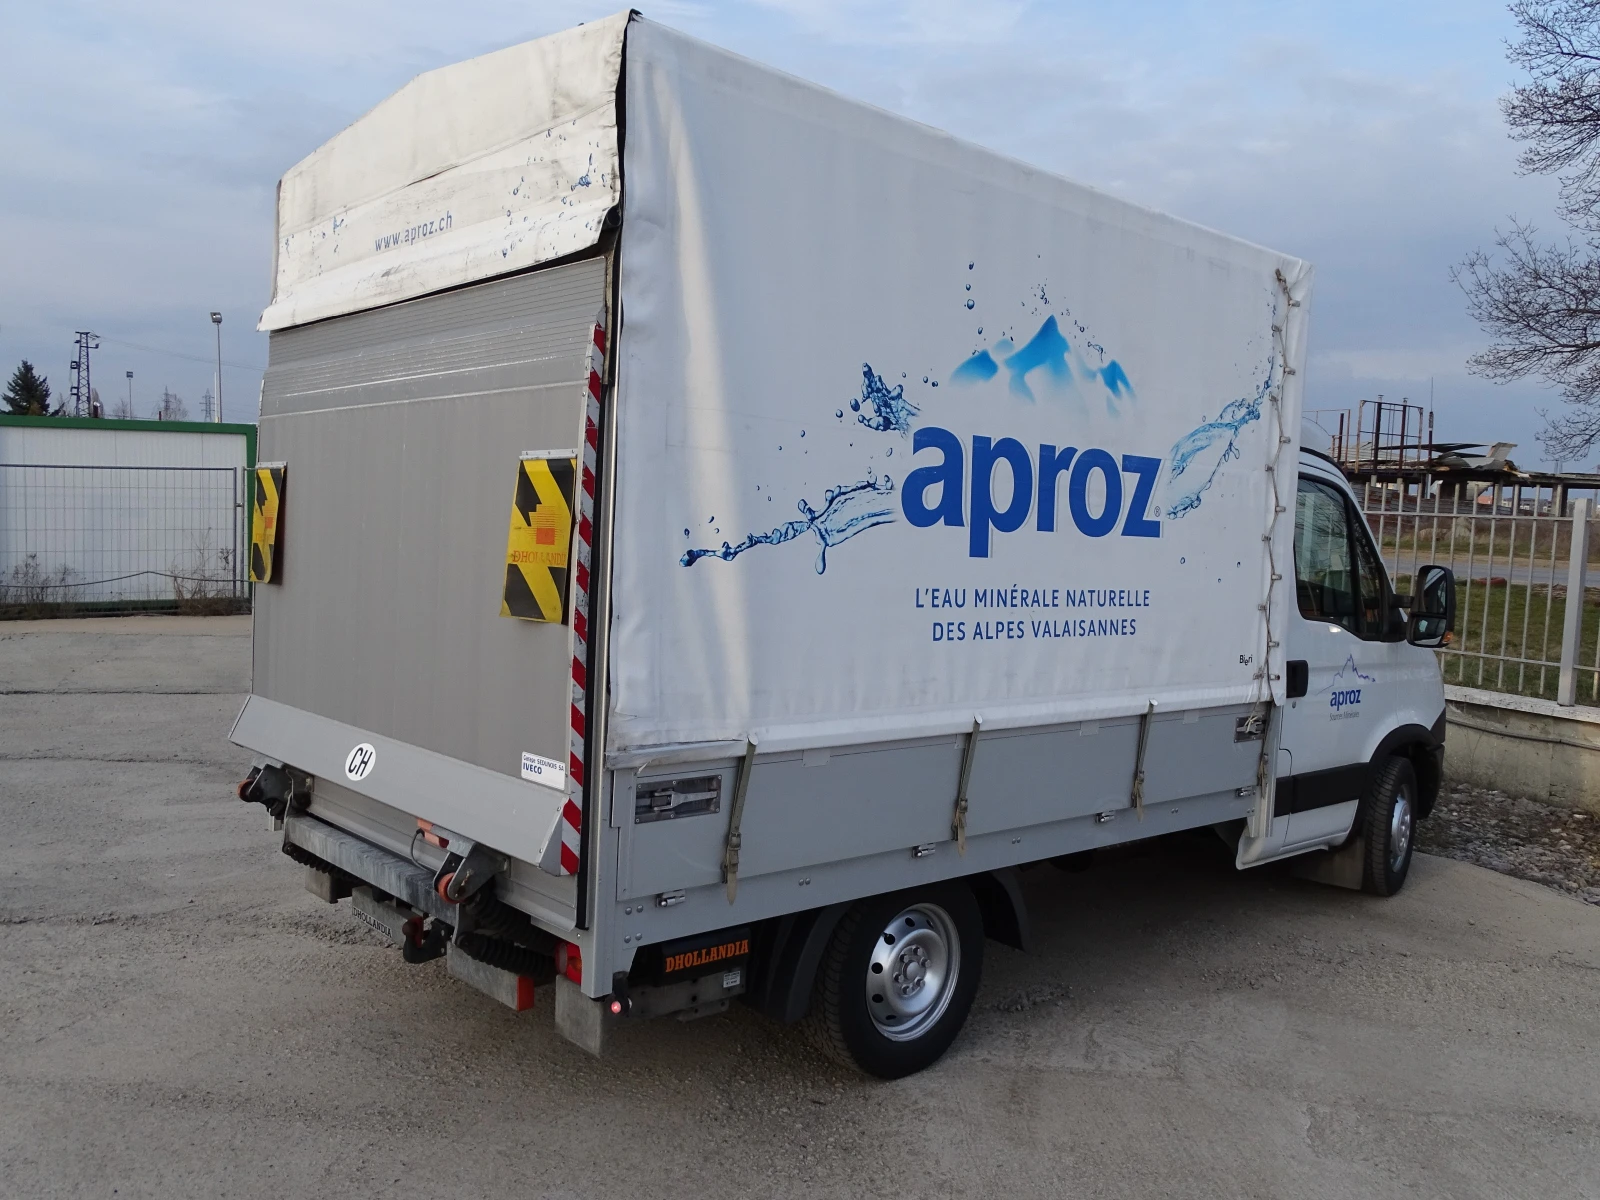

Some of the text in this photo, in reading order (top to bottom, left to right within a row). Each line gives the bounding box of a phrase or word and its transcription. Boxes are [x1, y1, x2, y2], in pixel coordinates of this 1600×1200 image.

[375, 210, 453, 252] www.aproz.ch
[901, 426, 1163, 558] aproz
[915, 583, 1150, 608] L'EAU MINÉRALE NATURELLE
[932, 618, 1137, 642] DES ALPES VALAISANNES
[1329, 688, 1362, 712] aproz
[348, 746, 374, 777] CH
[522, 761, 543, 775] IVECO
[352, 906, 393, 938] DHOLLANDIA
[665, 939, 749, 973] DHOLLANDIA
